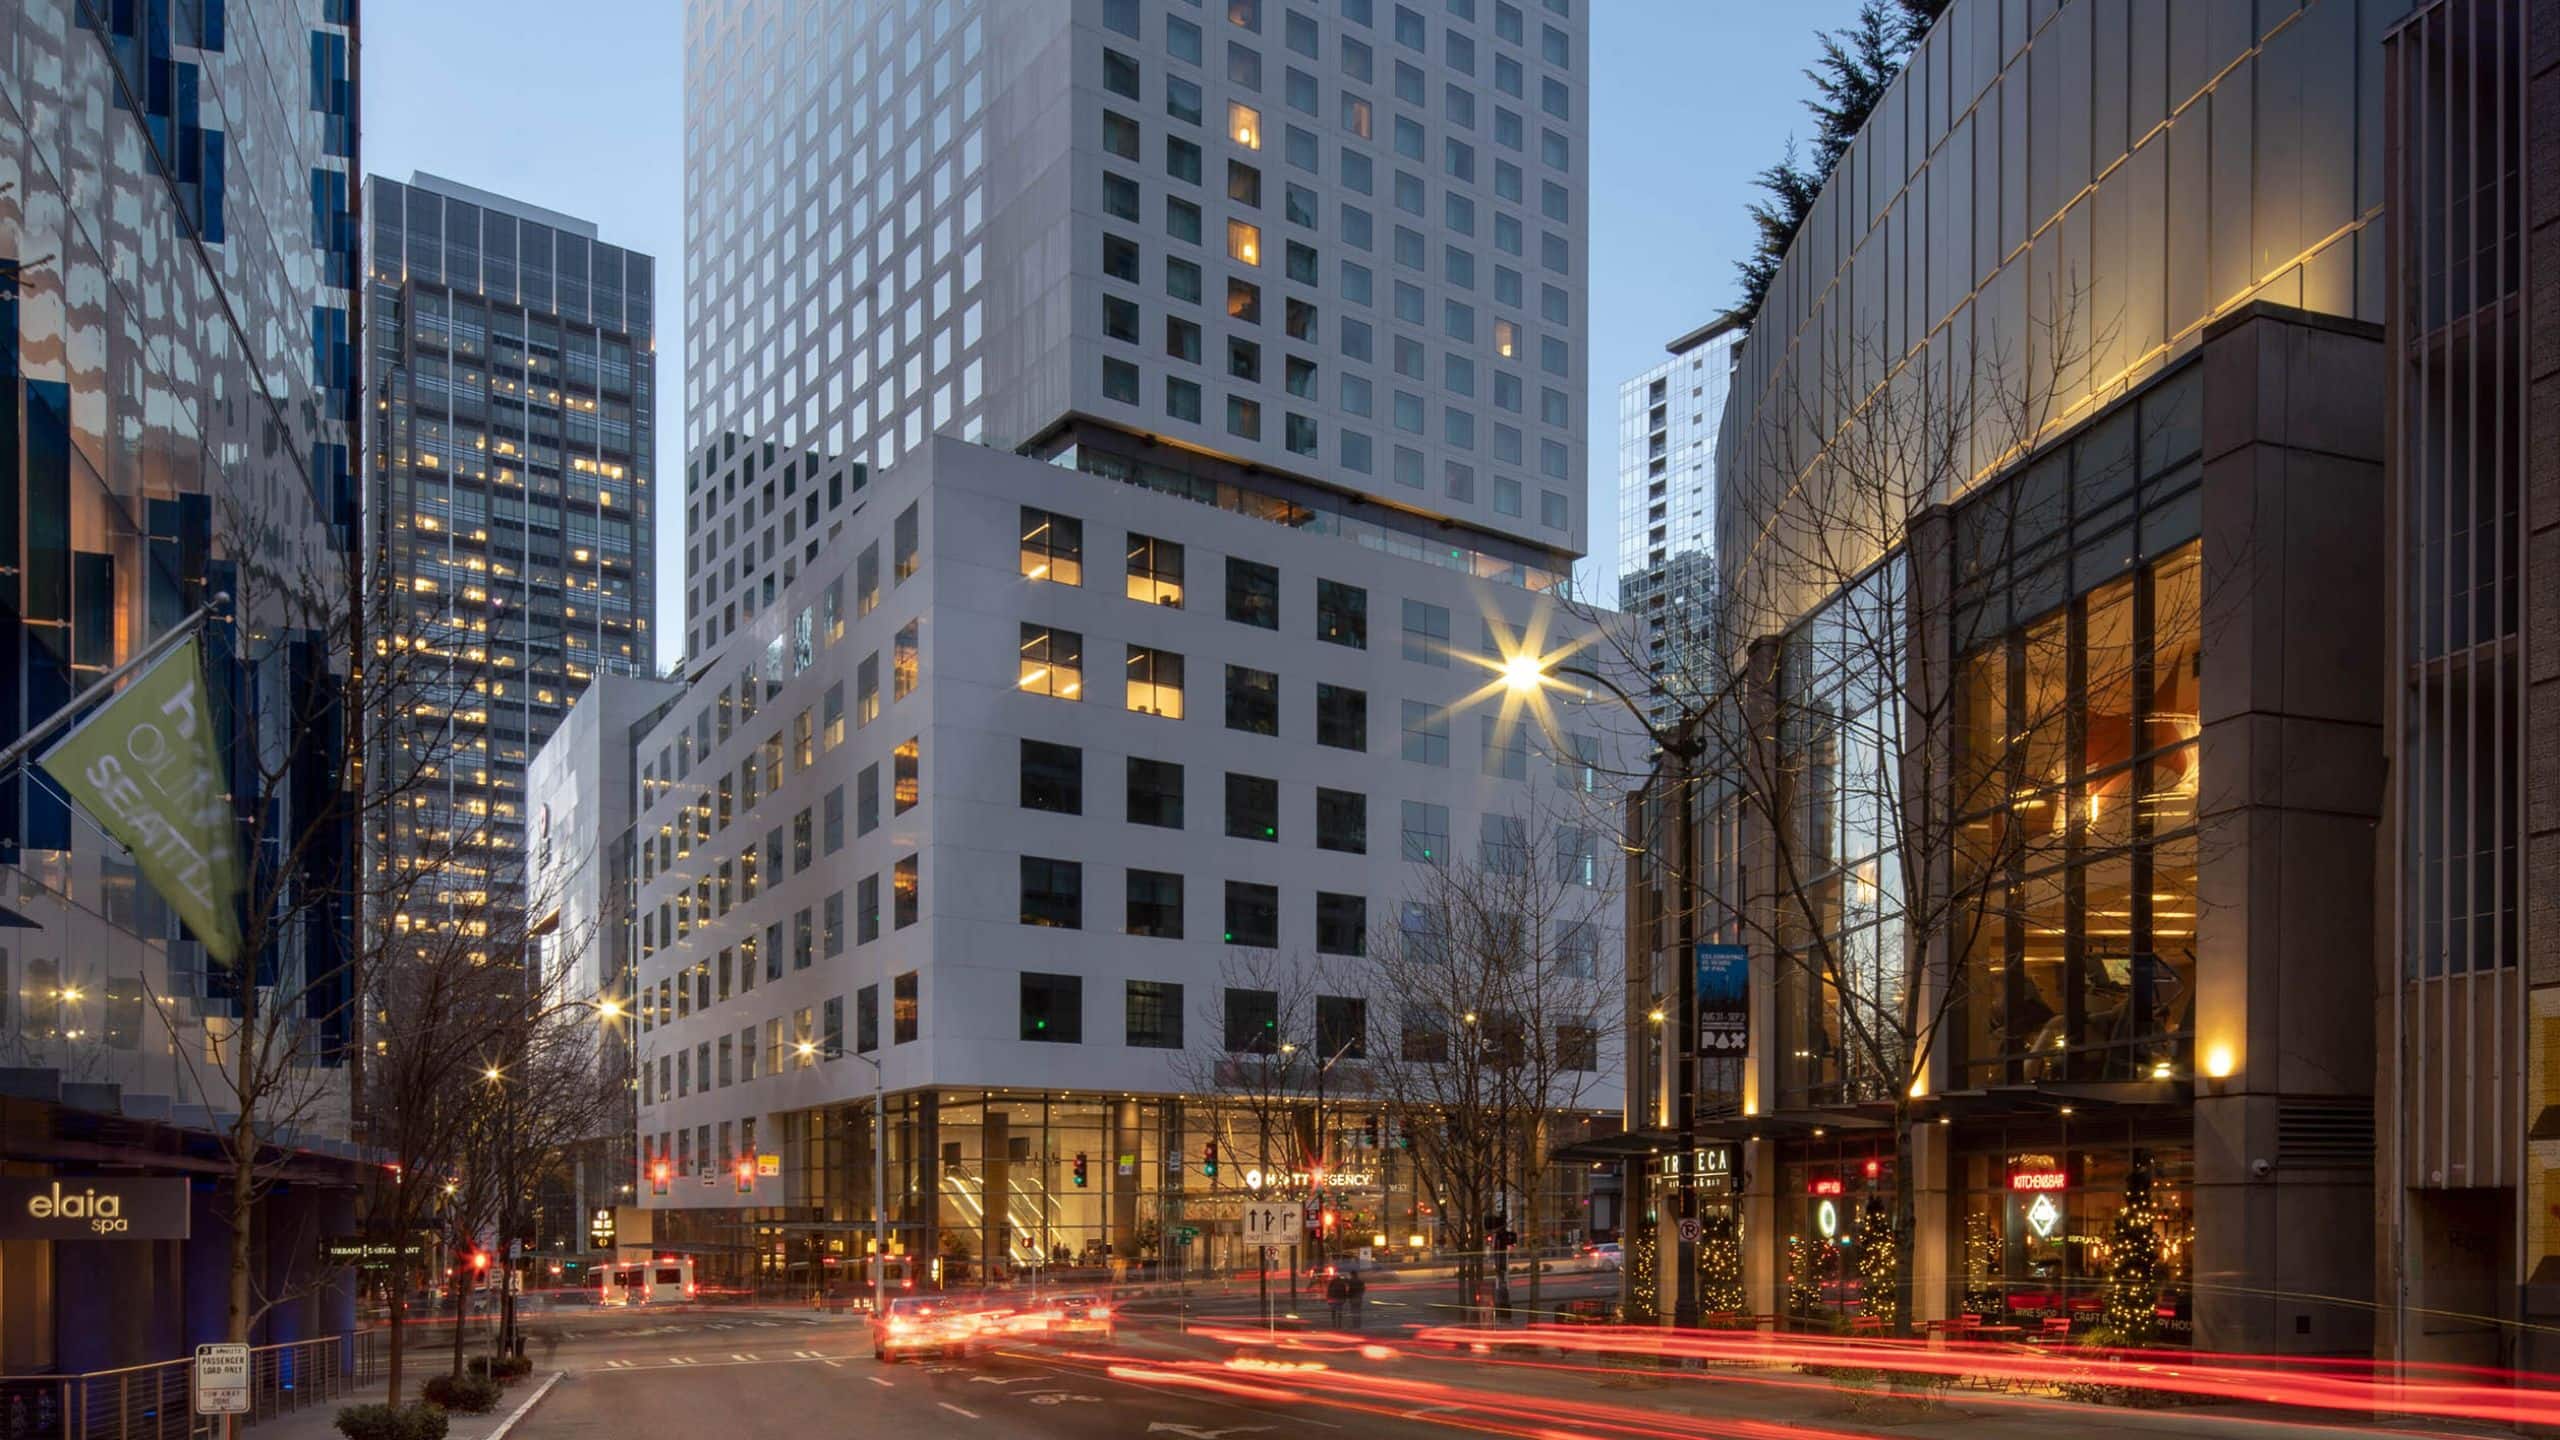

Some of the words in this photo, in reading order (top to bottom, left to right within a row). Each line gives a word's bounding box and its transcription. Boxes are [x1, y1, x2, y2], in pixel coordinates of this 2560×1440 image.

[1702, 1031, 1746, 1049] PAX
[1663, 1149, 1727, 1173] TRECA
[1314, 1173, 1370, 1186] EGENCY
[28, 1182, 119, 1218] elaia
[91, 1219, 128, 1235] spa
[202, 1357, 244, 1365] PASSENGER
